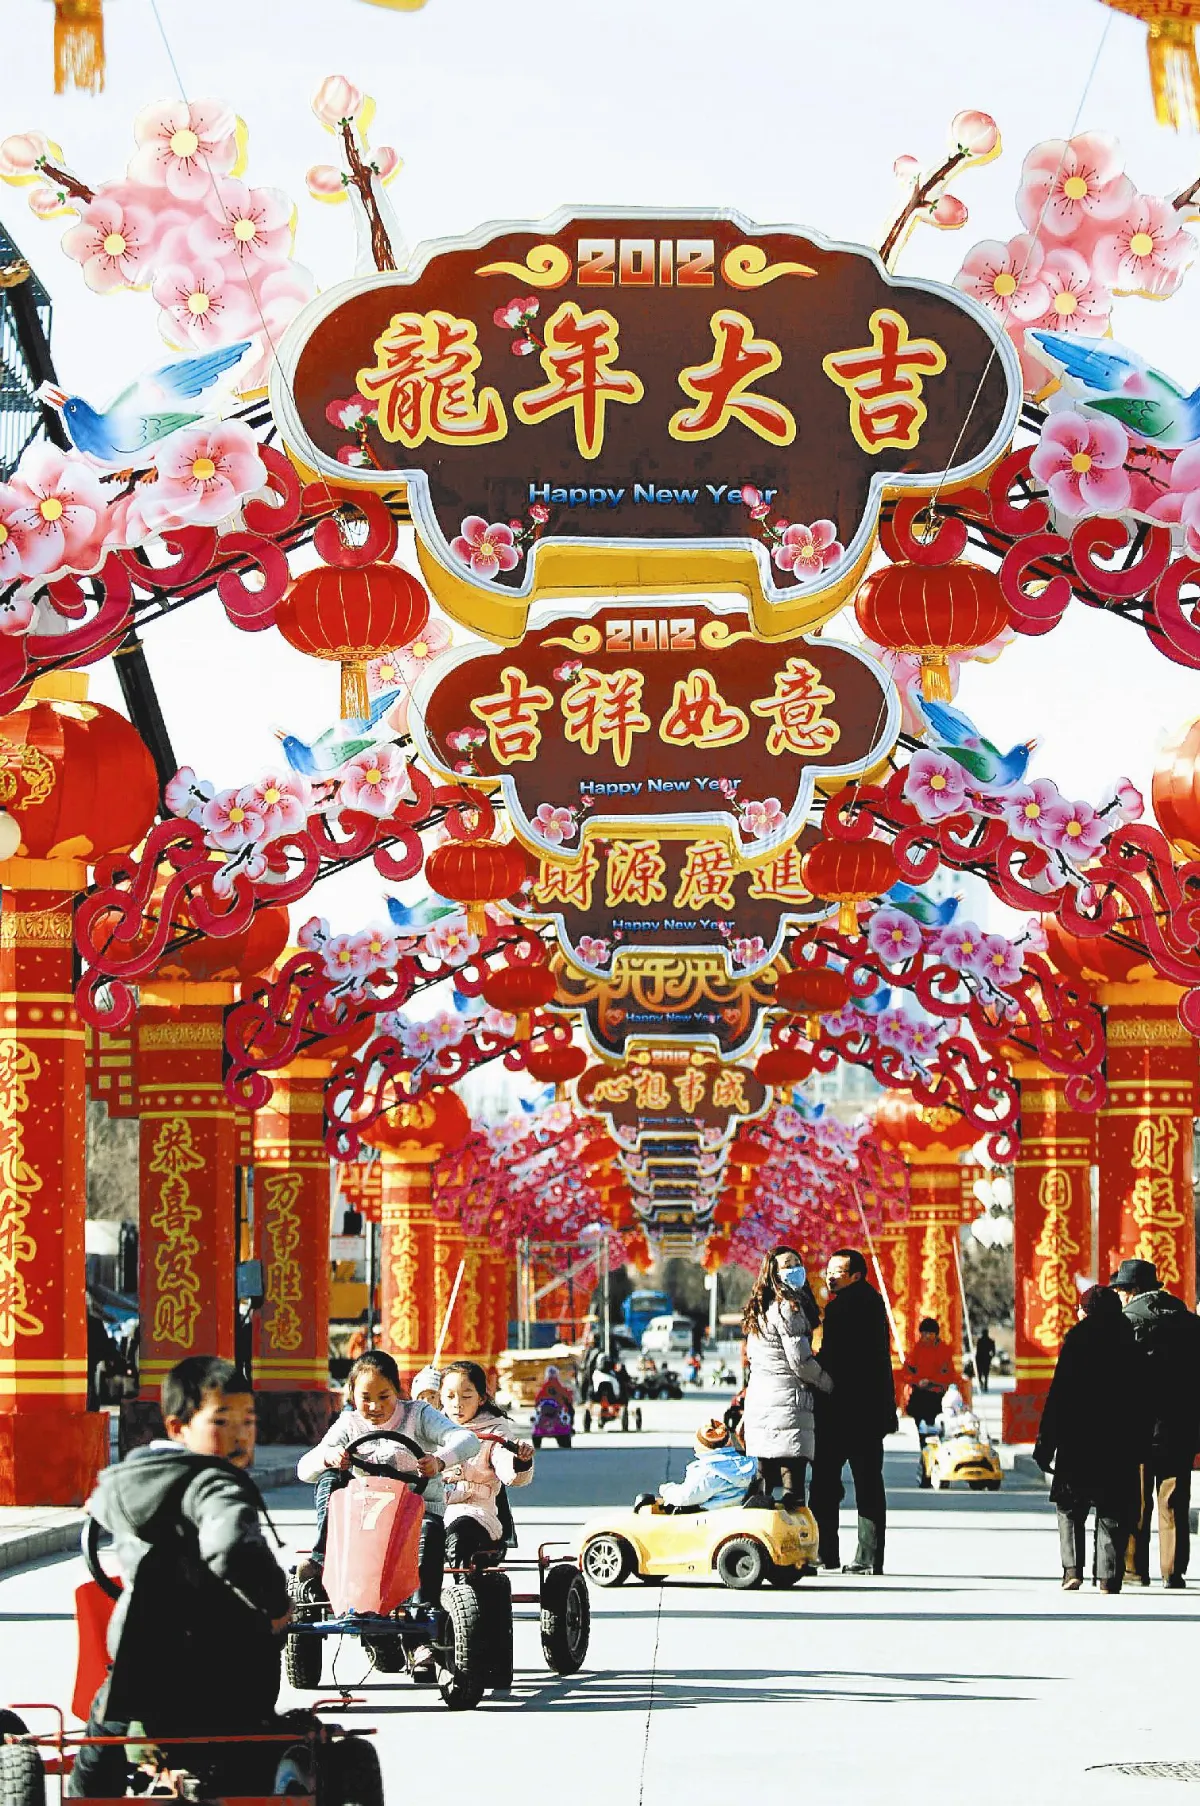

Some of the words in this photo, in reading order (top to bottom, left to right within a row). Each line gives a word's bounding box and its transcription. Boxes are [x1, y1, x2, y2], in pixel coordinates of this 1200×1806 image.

[577, 238, 716, 288] 2012
[356, 301, 947, 460] 龍年大吉
[529, 483, 625, 508] Happy
[634, 483, 699, 505] New
[706, 483, 778, 505] Yer
[605, 618, 696, 652] 2012
[470, 657, 841, 767] 吉祥如意
[579, 780, 643, 796] Happy
[648, 778, 691, 793] New
[694, 777, 742, 791] Yer
[612, 919, 660, 932] Happy
[663, 919, 697, 931] New
[699, 919, 736, 931] Yer
[694, 1012, 722, 1022] Yer
[150, 1116, 206, 1349] 恭喜发财
[1034, 1167, 1080, 1348] 国泰民安
[353, 1491, 396, 1531] 7
